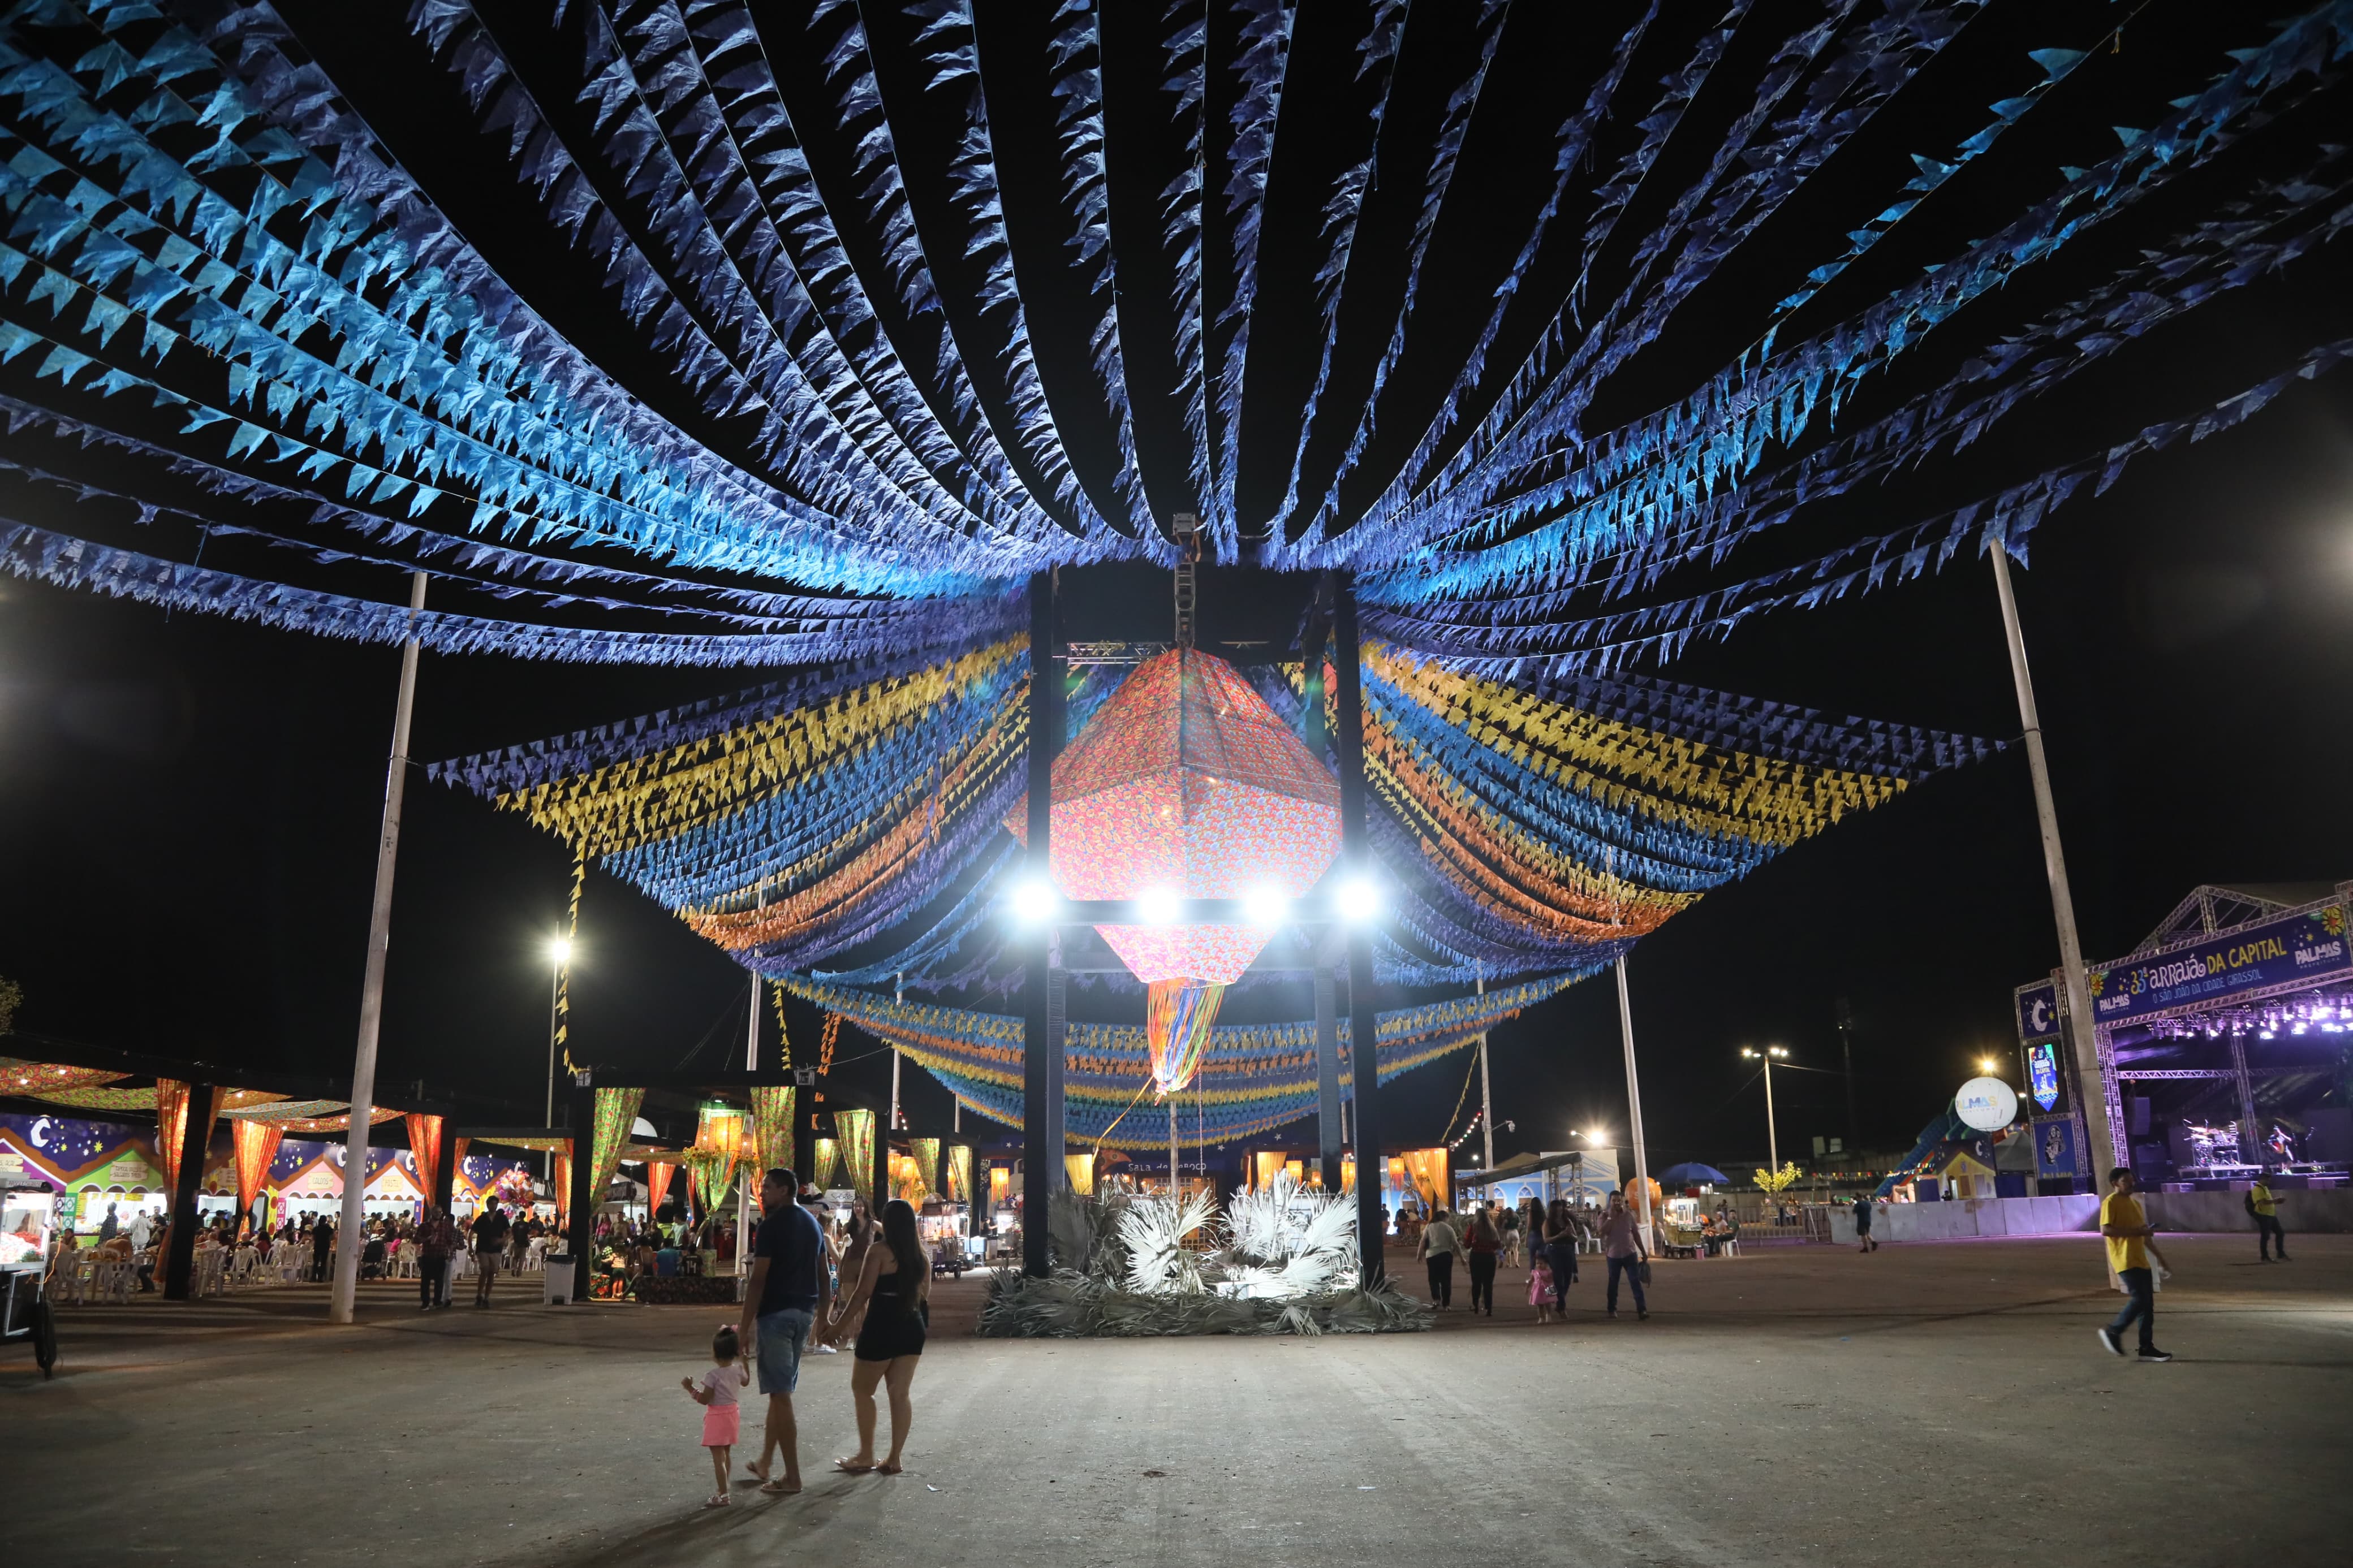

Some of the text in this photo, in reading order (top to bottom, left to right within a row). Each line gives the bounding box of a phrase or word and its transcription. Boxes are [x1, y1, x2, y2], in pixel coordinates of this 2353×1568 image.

[2207, 953, 2227, 974] DA
[2229, 936, 2287, 968] CAPITAL
[2294, 941, 2341, 965] PALMAS
[2152, 968, 2262, 1003] O SÃO JOÃO DA CIDADE GIRASSOL
[2099, 994, 2130, 1012] PALMAS
